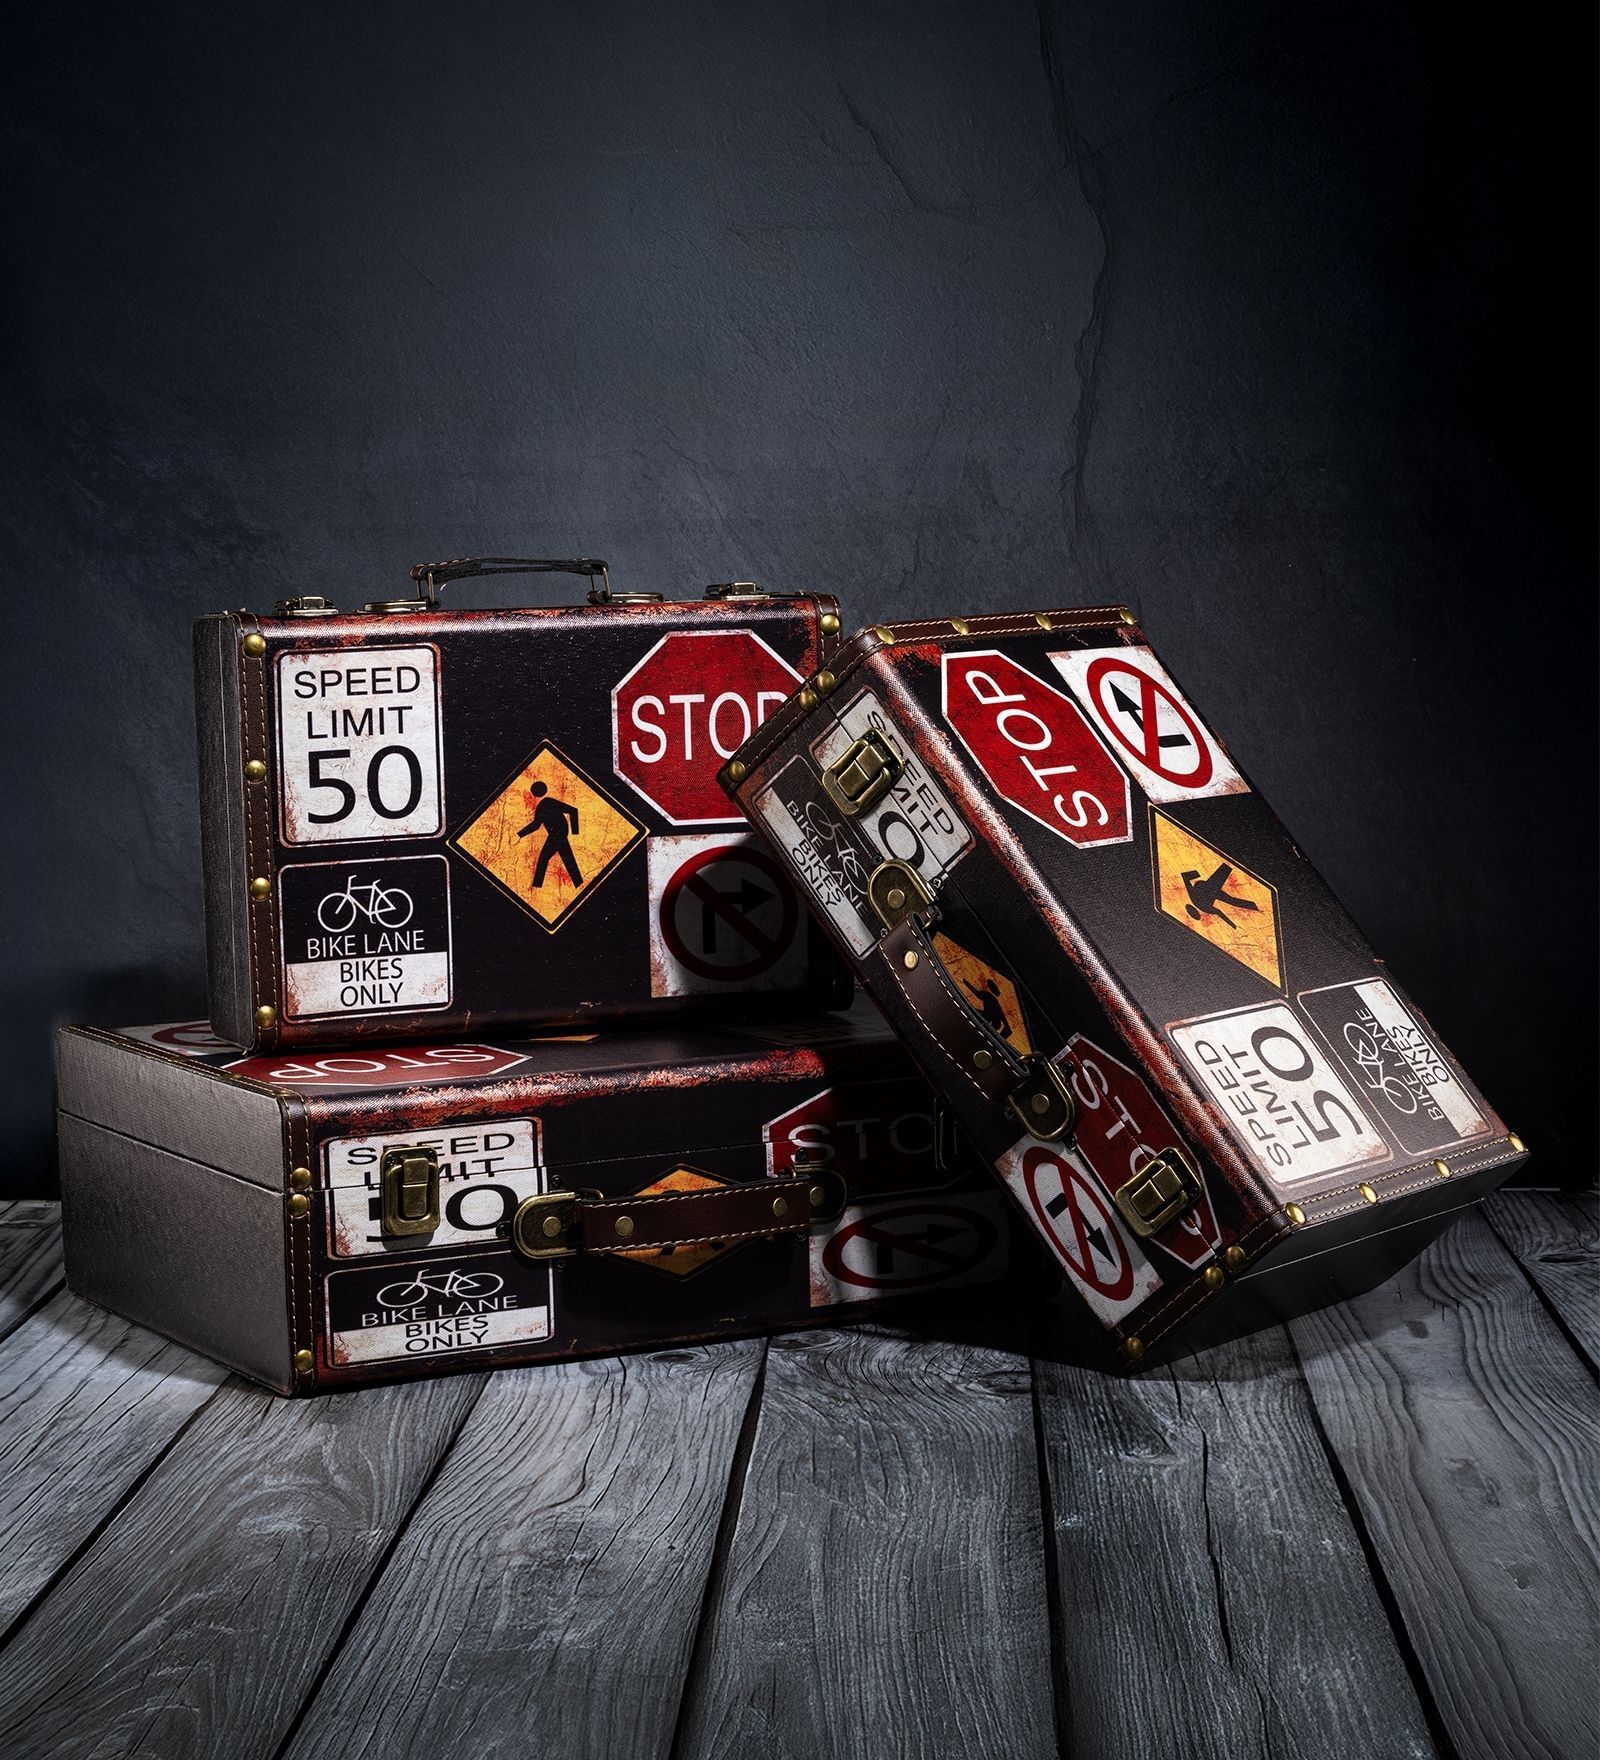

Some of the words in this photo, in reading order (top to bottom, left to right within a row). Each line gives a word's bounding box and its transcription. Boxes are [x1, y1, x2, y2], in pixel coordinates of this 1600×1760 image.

[294, 666, 420, 699] SPEED
[307, 706, 413, 739] LIMIT
[965, 670, 1109, 827] STOP
[307, 745, 423, 825] 50
[787, 800, 824, 852] BIKE
[823, 854, 870, 918] LANE
[792, 847, 838, 906] ONLY
[799, 838, 845, 902] BIKES
[307, 936, 357, 959] BIKE
[364, 930, 425, 953] LANE
[339, 958, 403, 984] BIKES
[339, 982, 403, 1007] ONLY
[269, 1049, 494, 1078] STOP
[1355, 1007, 1406, 1067] LANE
[1386, 1026, 1438, 1086] BIKES
[1399, 1025, 1450, 1082] ONLY
[1194, 1040, 1292, 1166] SPEED
[1222, 1044, 1312, 1149] LIMIT
[1251, 1026, 1363, 1142] 50
[1402, 1071, 1445, 1120] BIKE
[788, 1112, 935, 1164] STO
[361, 1306, 428, 1327] BIKE
[438, 1295, 518, 1317] LANE
[405, 1315, 489, 1338] BIKES
[405, 1329, 489, 1352] ONLY
